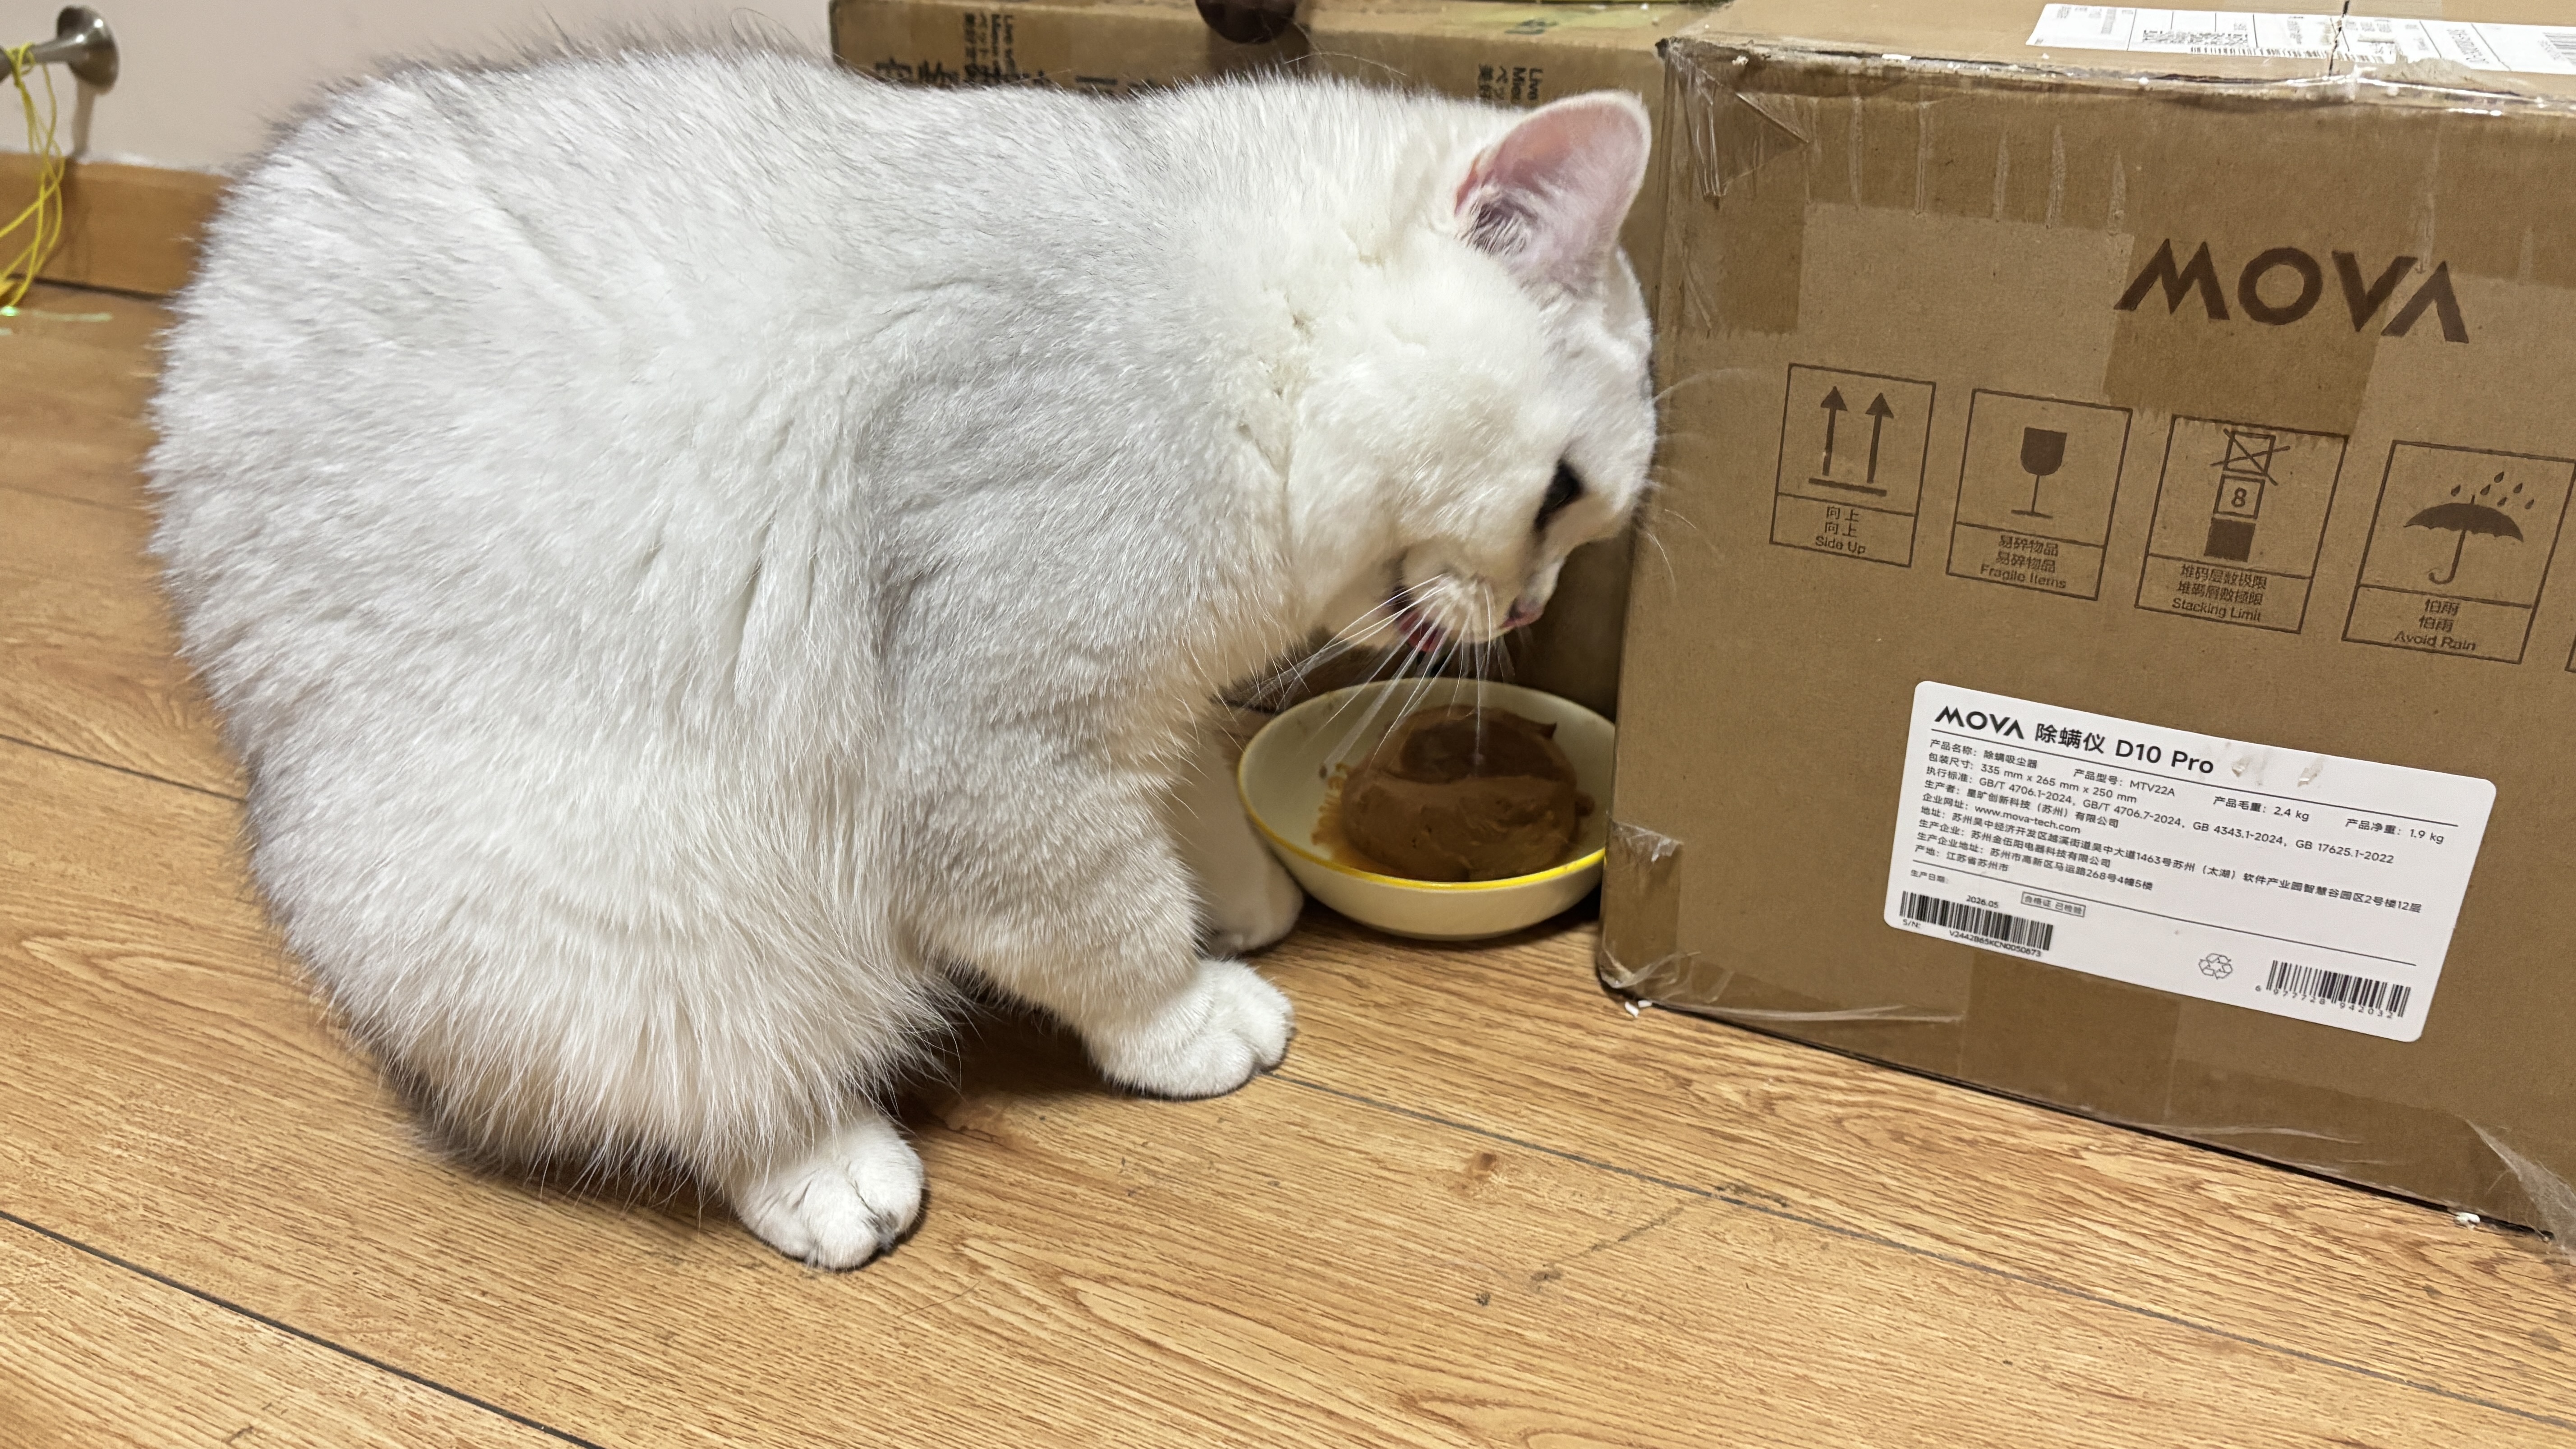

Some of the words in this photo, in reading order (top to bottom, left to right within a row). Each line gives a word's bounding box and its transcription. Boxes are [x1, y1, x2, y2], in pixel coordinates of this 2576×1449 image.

[2113, 238, 2469, 344] MOVA
[2231, 487, 2247, 508] 8
[1815, 535, 1844, 550] Side
[1848, 541, 1866, 555] Up
[1998, 534, 2059, 557] 易碎物品
[1996, 550, 2056, 574] 易碎物品
[1980, 563, 2026, 582] Fragile
[2029, 571, 2067, 589] Items
[2180, 564, 2268, 590] 堆码层数极限
[2171, 597, 2226, 619] Stacking
[2230, 607, 2261, 622] Limit
[2424, 598, 2460, 616] 怕雨
[2419, 615, 2455, 633] 怕雨
[2393, 630, 2438, 648] Avoid
[2440, 635, 2477, 651] Rain
[1934, 705, 2024, 740] MOVA
[2034, 722, 2106, 754] 除螨仪
[2115, 739, 2162, 764] D10
[2171, 750, 2214, 774] Pro
[2003, 770, 2023, 780] mm
[2036, 774, 2056, 786] 265
[2059, 782, 2079, 791] mm
[2092, 787, 2113, 798] 250
[2116, 793, 2137, 804] mm
[2129, 779, 2175, 797] MTV22A
[2273, 805, 2291, 817] 2.4
[2295, 810, 2309, 822] kg
[2083, 799, 2111, 812] GB/T
[2192, 821, 2209, 832] GB
[2295, 839, 2313, 850] GB
[2318, 842, 2394, 864] 17625.1-2022
[2410, 828, 2426, 838] 1.9
[2429, 832, 2444, 845] kg
